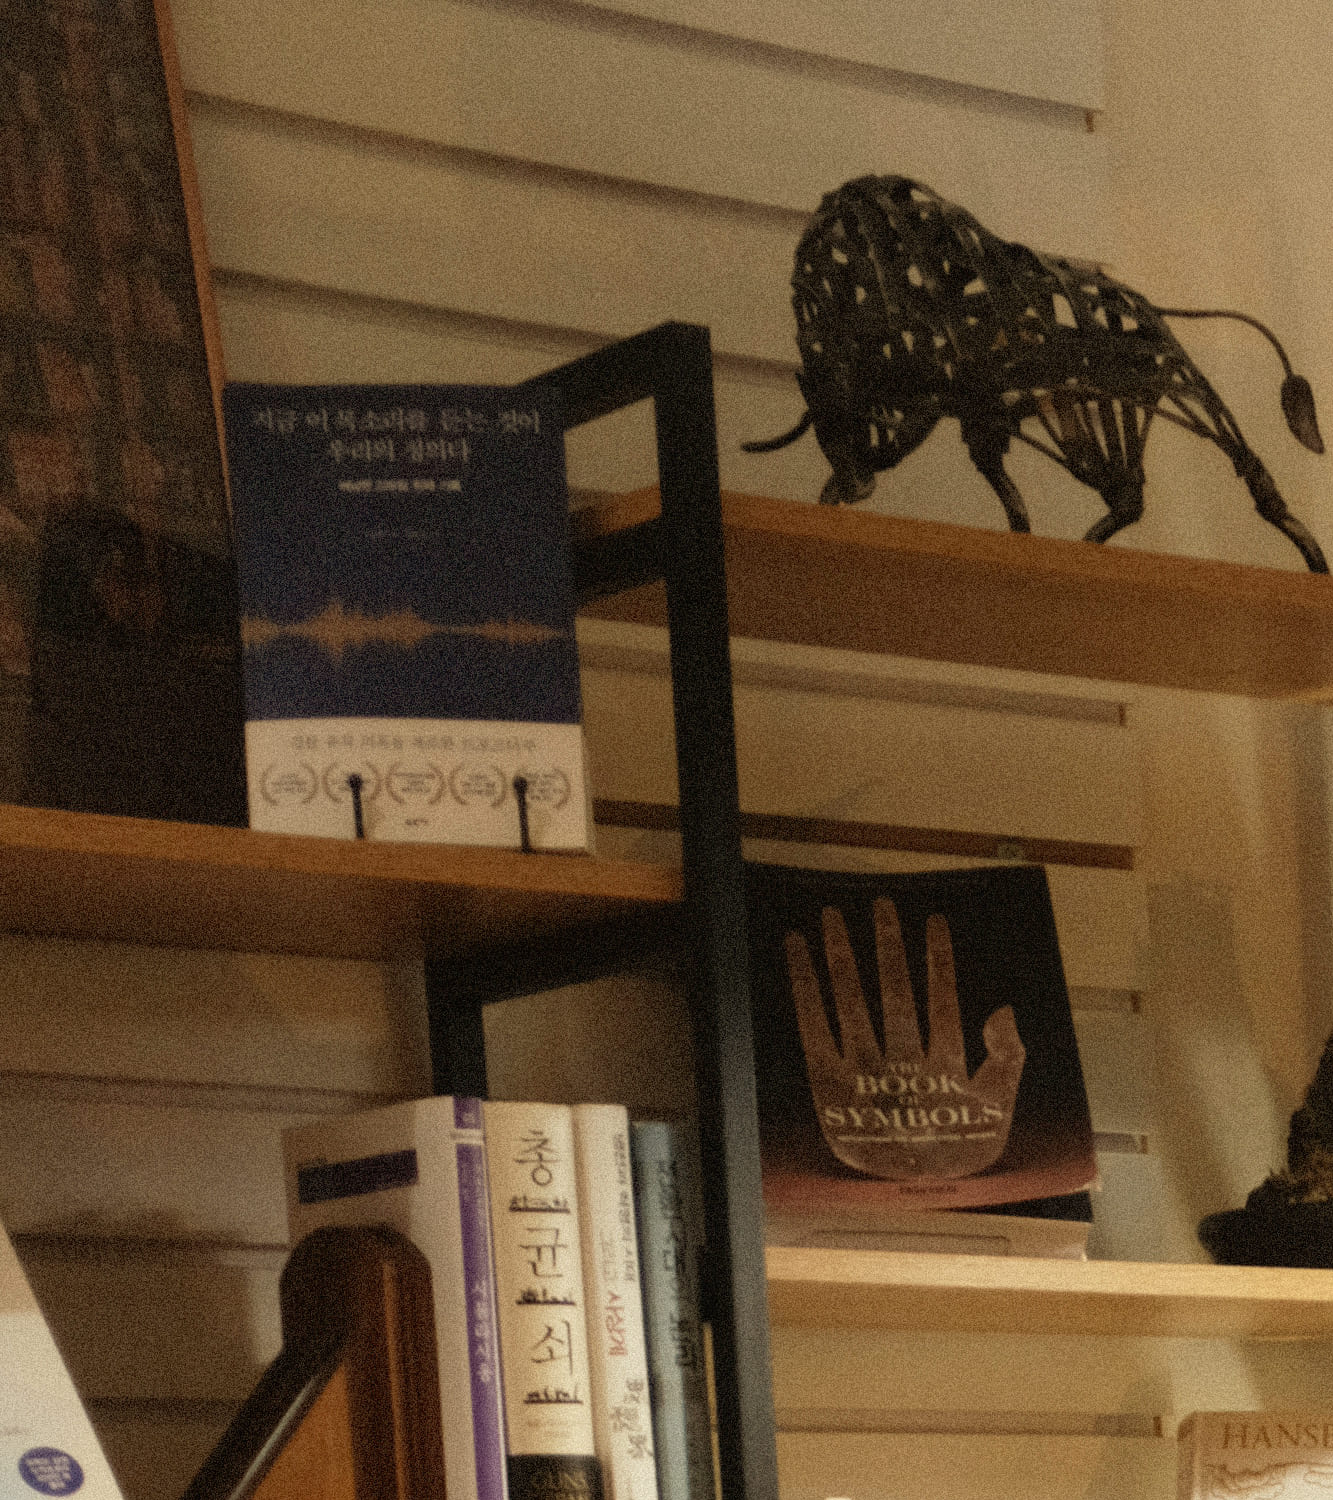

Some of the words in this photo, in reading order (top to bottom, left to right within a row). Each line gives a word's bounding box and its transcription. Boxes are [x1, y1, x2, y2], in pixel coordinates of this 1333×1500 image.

[854, 1073, 965, 1096] BOOK
[823, 1104, 1004, 1129] SYMBOLS
[514, 1130, 562, 1188] 총
[517, 1226, 569, 1280] 균
[529, 1318, 575, 1378] 쇠
